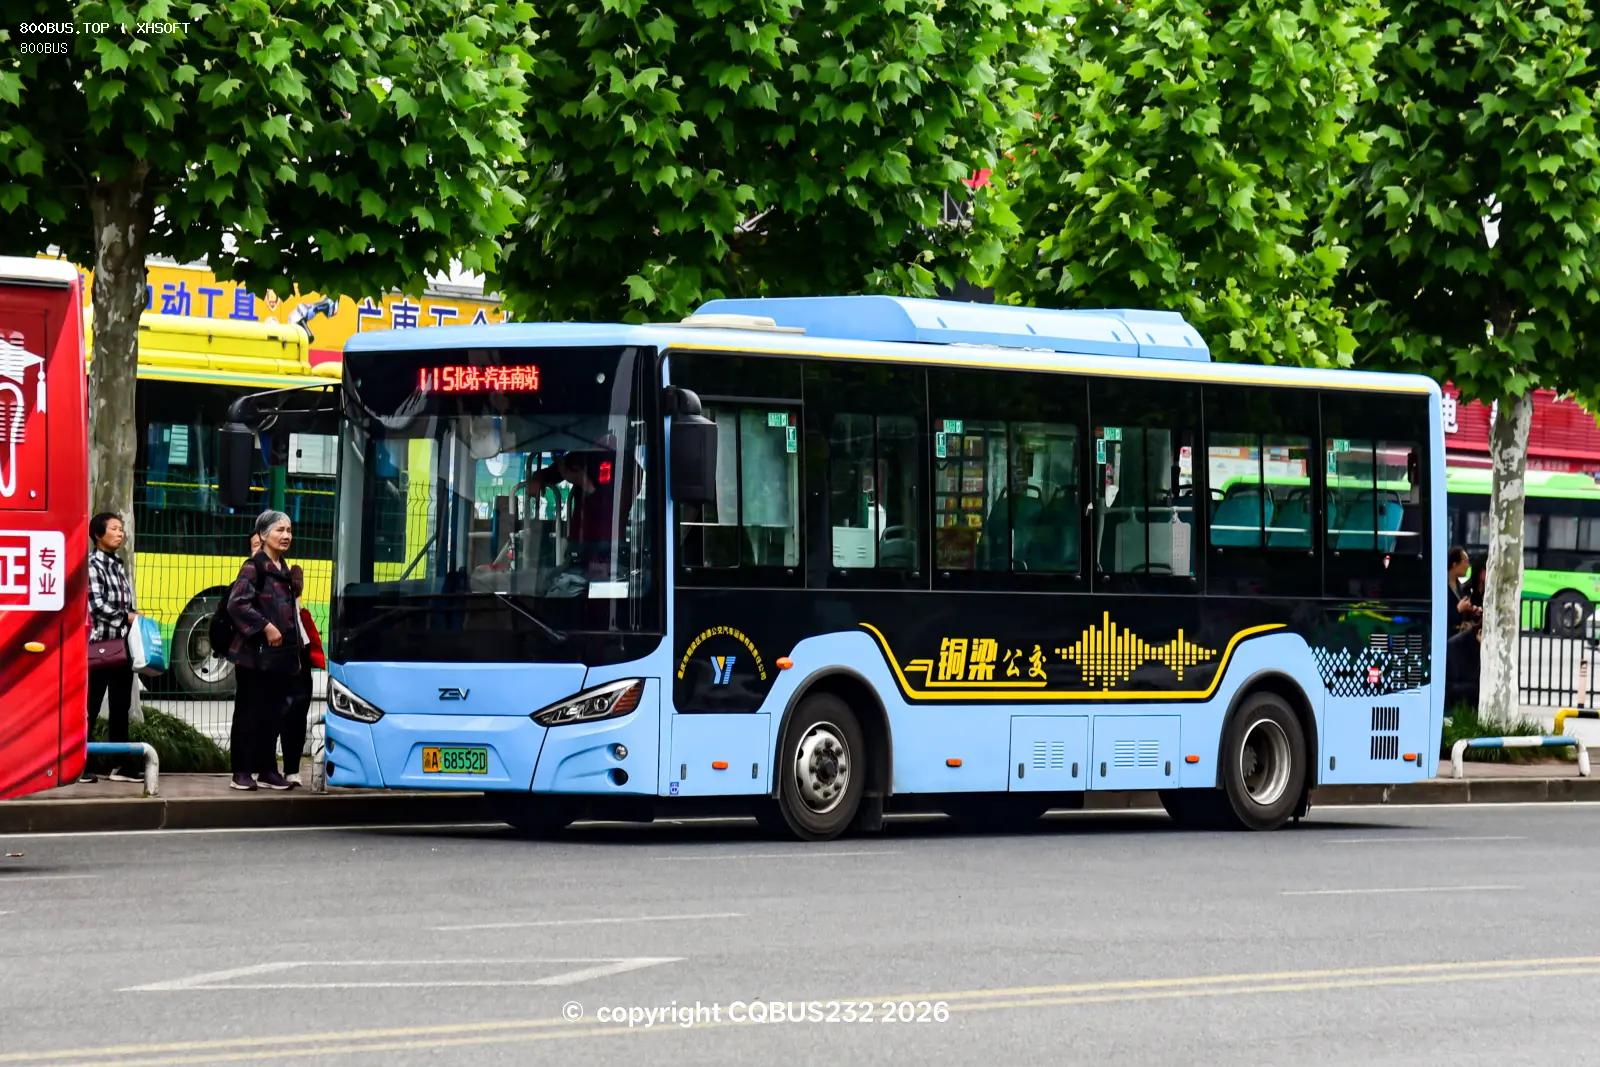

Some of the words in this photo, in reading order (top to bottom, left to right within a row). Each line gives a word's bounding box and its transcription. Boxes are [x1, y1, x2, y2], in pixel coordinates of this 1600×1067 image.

[146, 281, 259, 321] 动工具
[38, 546, 57, 595] 专业
[937, 637, 999, 681] 铜梁
[1002, 644, 1048, 681] 公交
